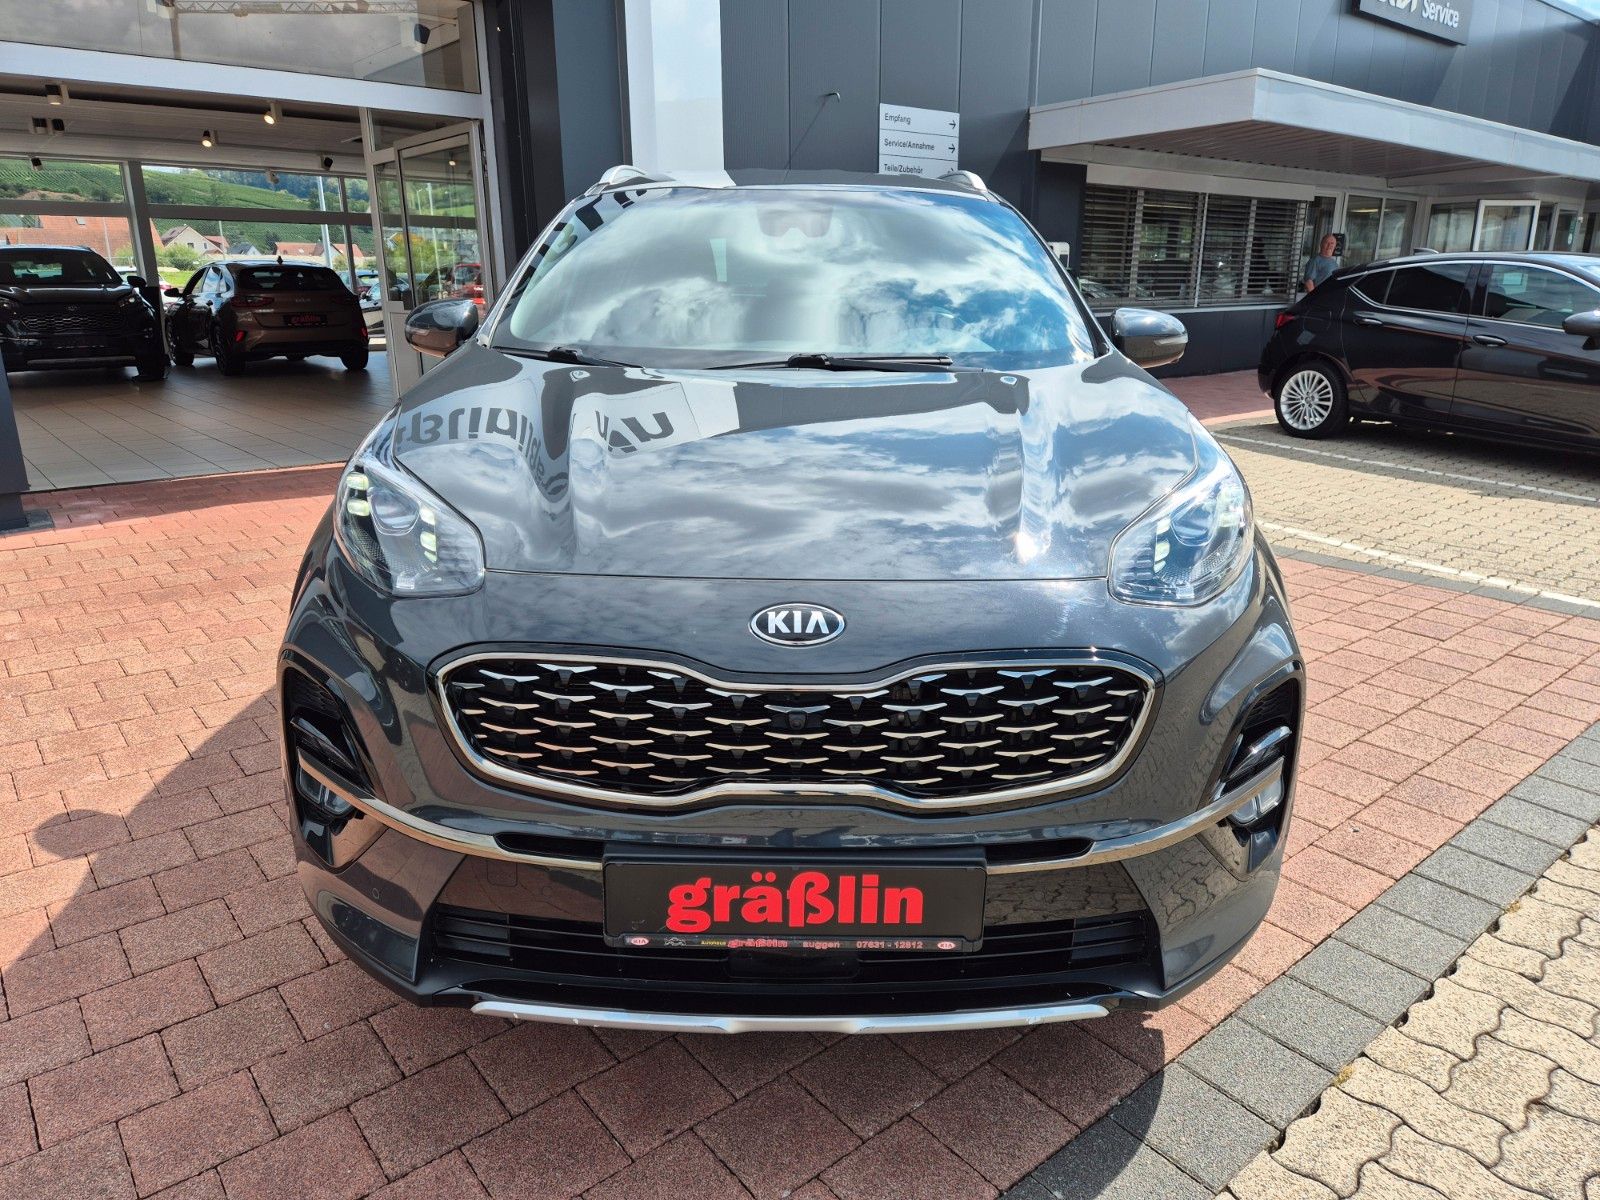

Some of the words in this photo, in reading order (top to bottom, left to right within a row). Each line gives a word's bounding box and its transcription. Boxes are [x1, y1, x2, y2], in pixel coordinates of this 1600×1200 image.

[1422, 0, 1459, 28] Service
[884, 113, 911, 125] Empfang
[884, 138, 935, 150] Service/Annahme
[767, 610, 830, 634] KIA
[665, 871, 924, 933] gräßlin
[727, 938, 788, 948] gräßlin
